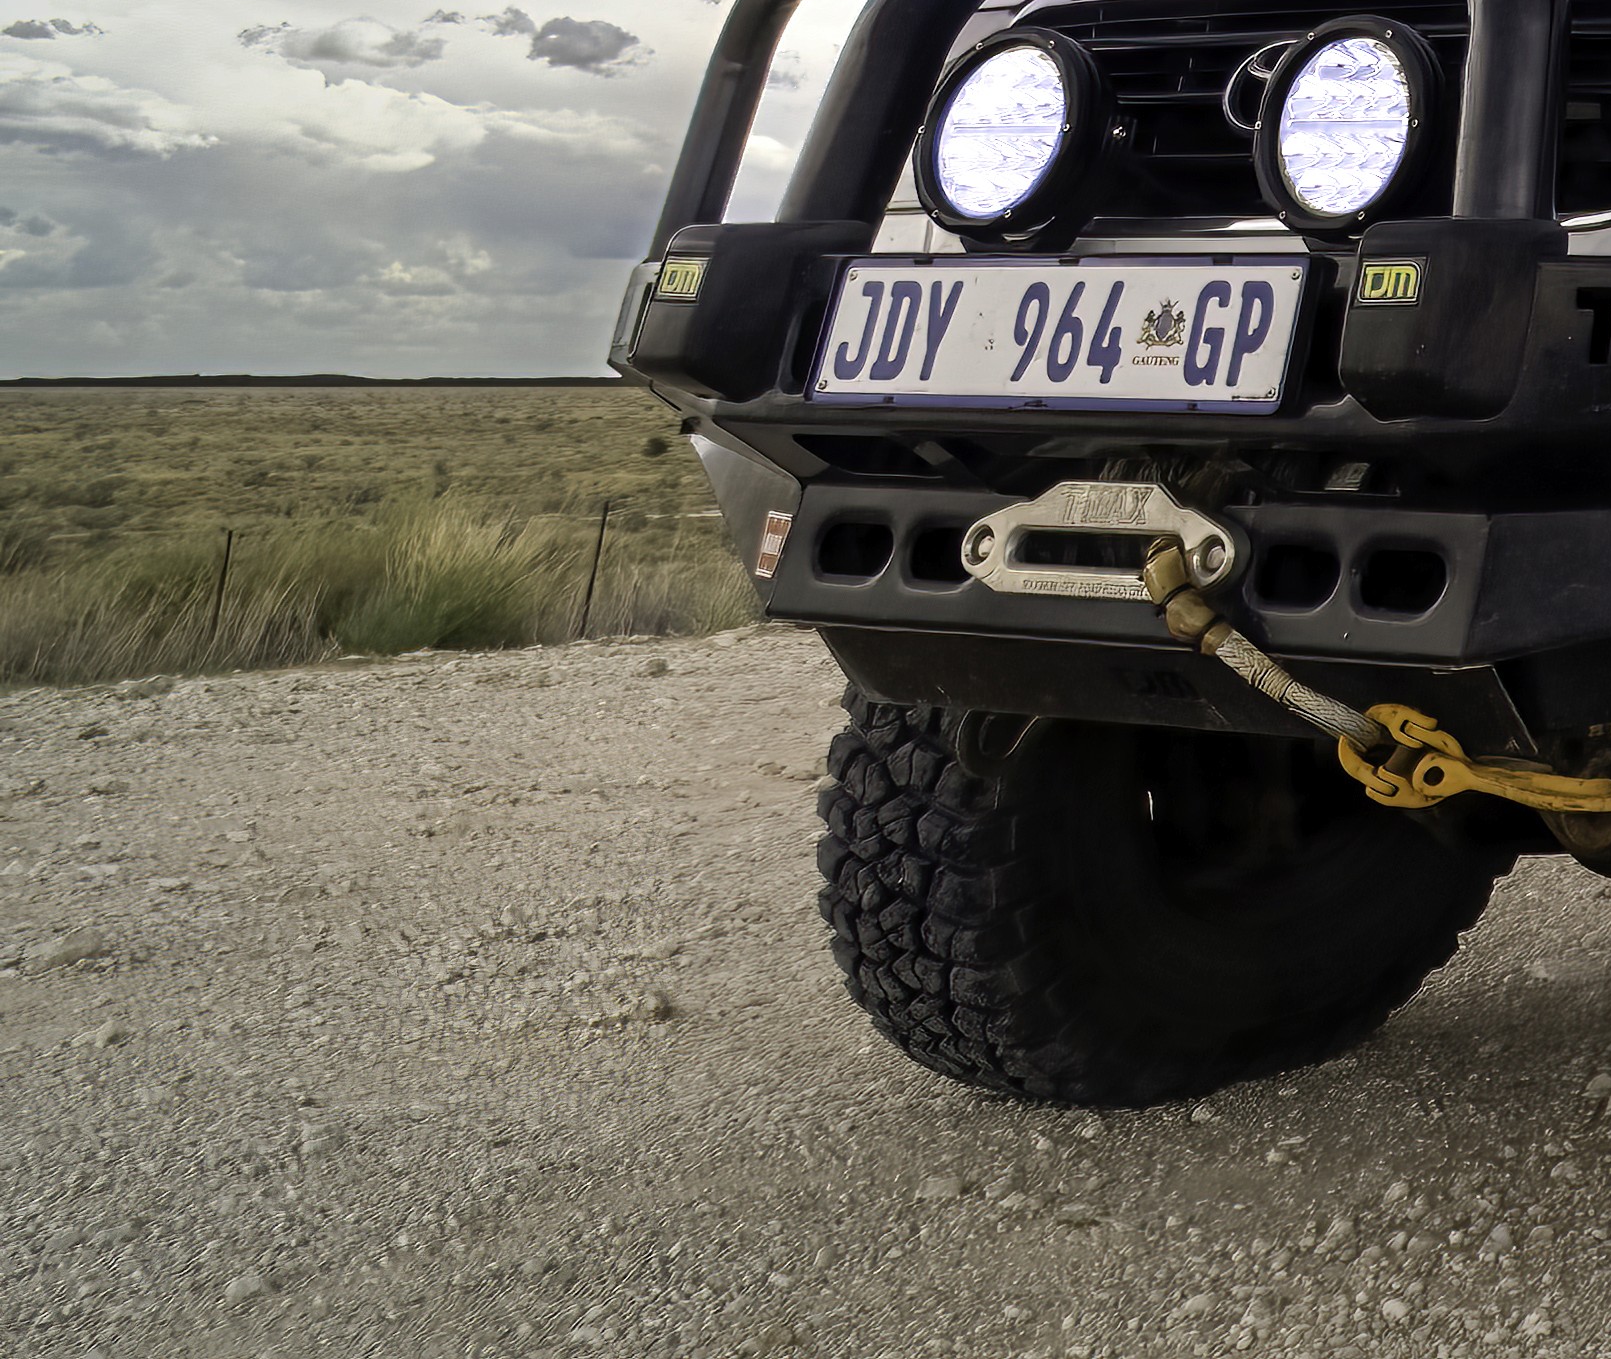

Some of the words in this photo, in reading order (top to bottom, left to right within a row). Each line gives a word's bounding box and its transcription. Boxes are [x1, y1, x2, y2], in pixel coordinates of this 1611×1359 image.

[834, 280, 964, 382] JDY
[1010, 280, 1123, 385] 964
[1183, 280, 1275, 387] GP
[1132, 355, 1180, 366] GAUTENG
